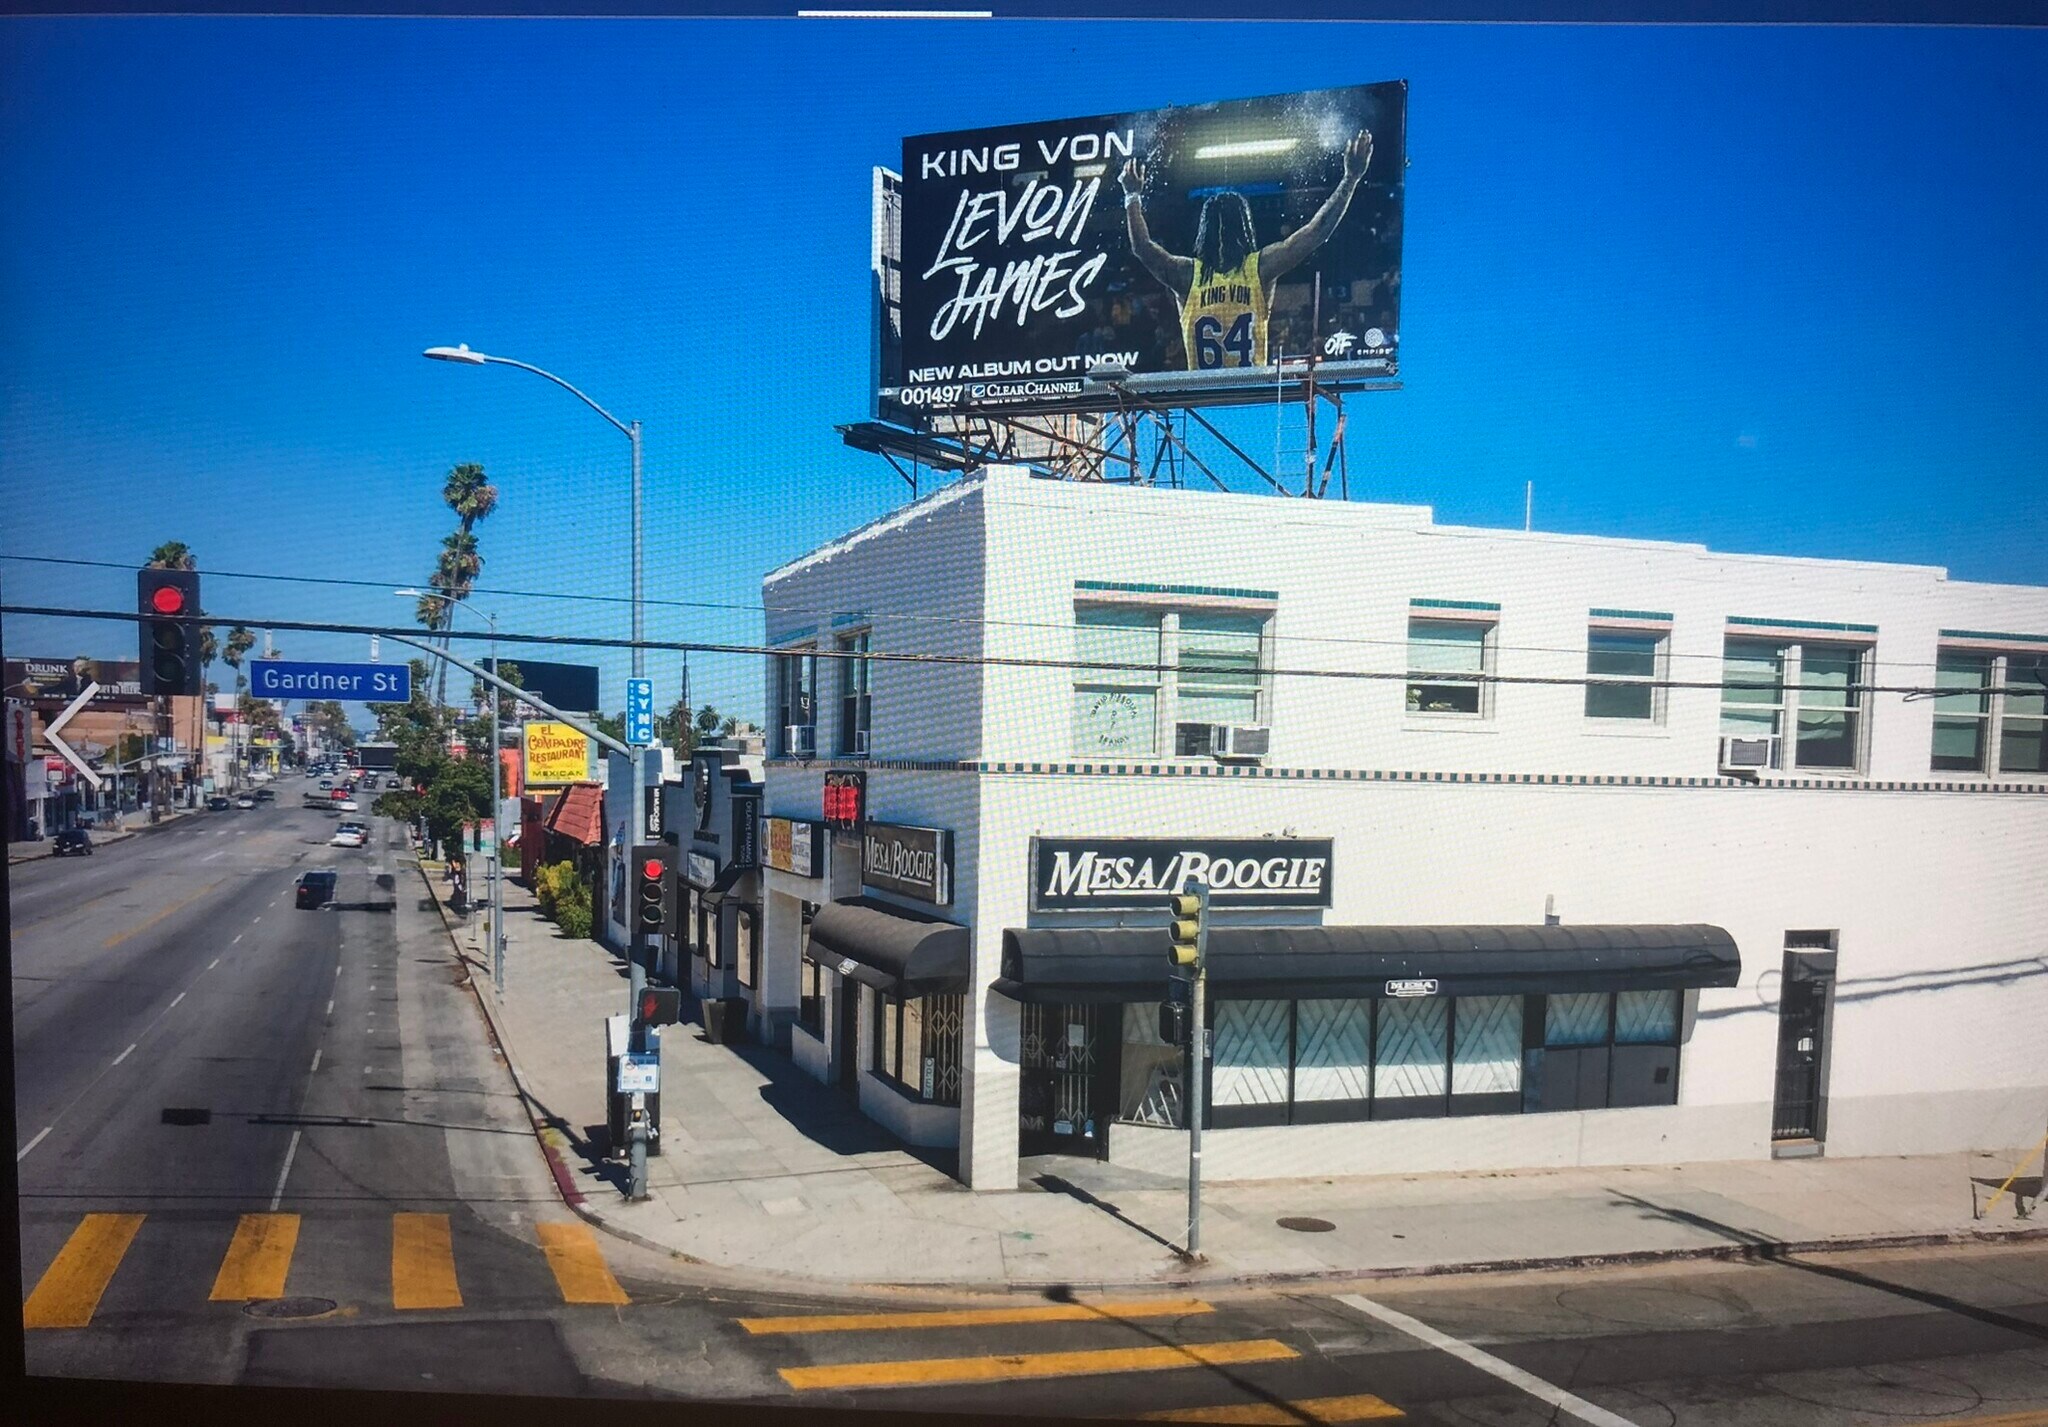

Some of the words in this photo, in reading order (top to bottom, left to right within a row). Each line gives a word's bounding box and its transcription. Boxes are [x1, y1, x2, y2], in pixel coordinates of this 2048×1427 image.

[921, 143, 1020, 179] KING
[1037, 129, 1135, 165] VON
[922, 177, 1101, 280] LEVON
[930, 249, 1108, 341] JAMES
[1200, 285, 1226, 308] KING
[1229, 283, 1251, 306] VON
[1194, 312, 1254, 369] 64
[908, 365, 955, 383] NEW
[958, 360, 1032, 379] ALBUM
[1035, 356, 1081, 373] OUT
[1084, 351, 1140, 369] NOW
[901, 385, 963, 405] 001497
[25, 663, 68, 673] DRUNK
[264, 669, 363, 690] Gardner
[373, 673, 399, 691] St
[638, 683, 650, 740] SYNC
[528, 734, 587, 751] COMPADRE
[541, 725, 554, 735] EL
[529, 749, 585, 763] RESTAURANT
[925, 1058, 933, 1098] OPEN
